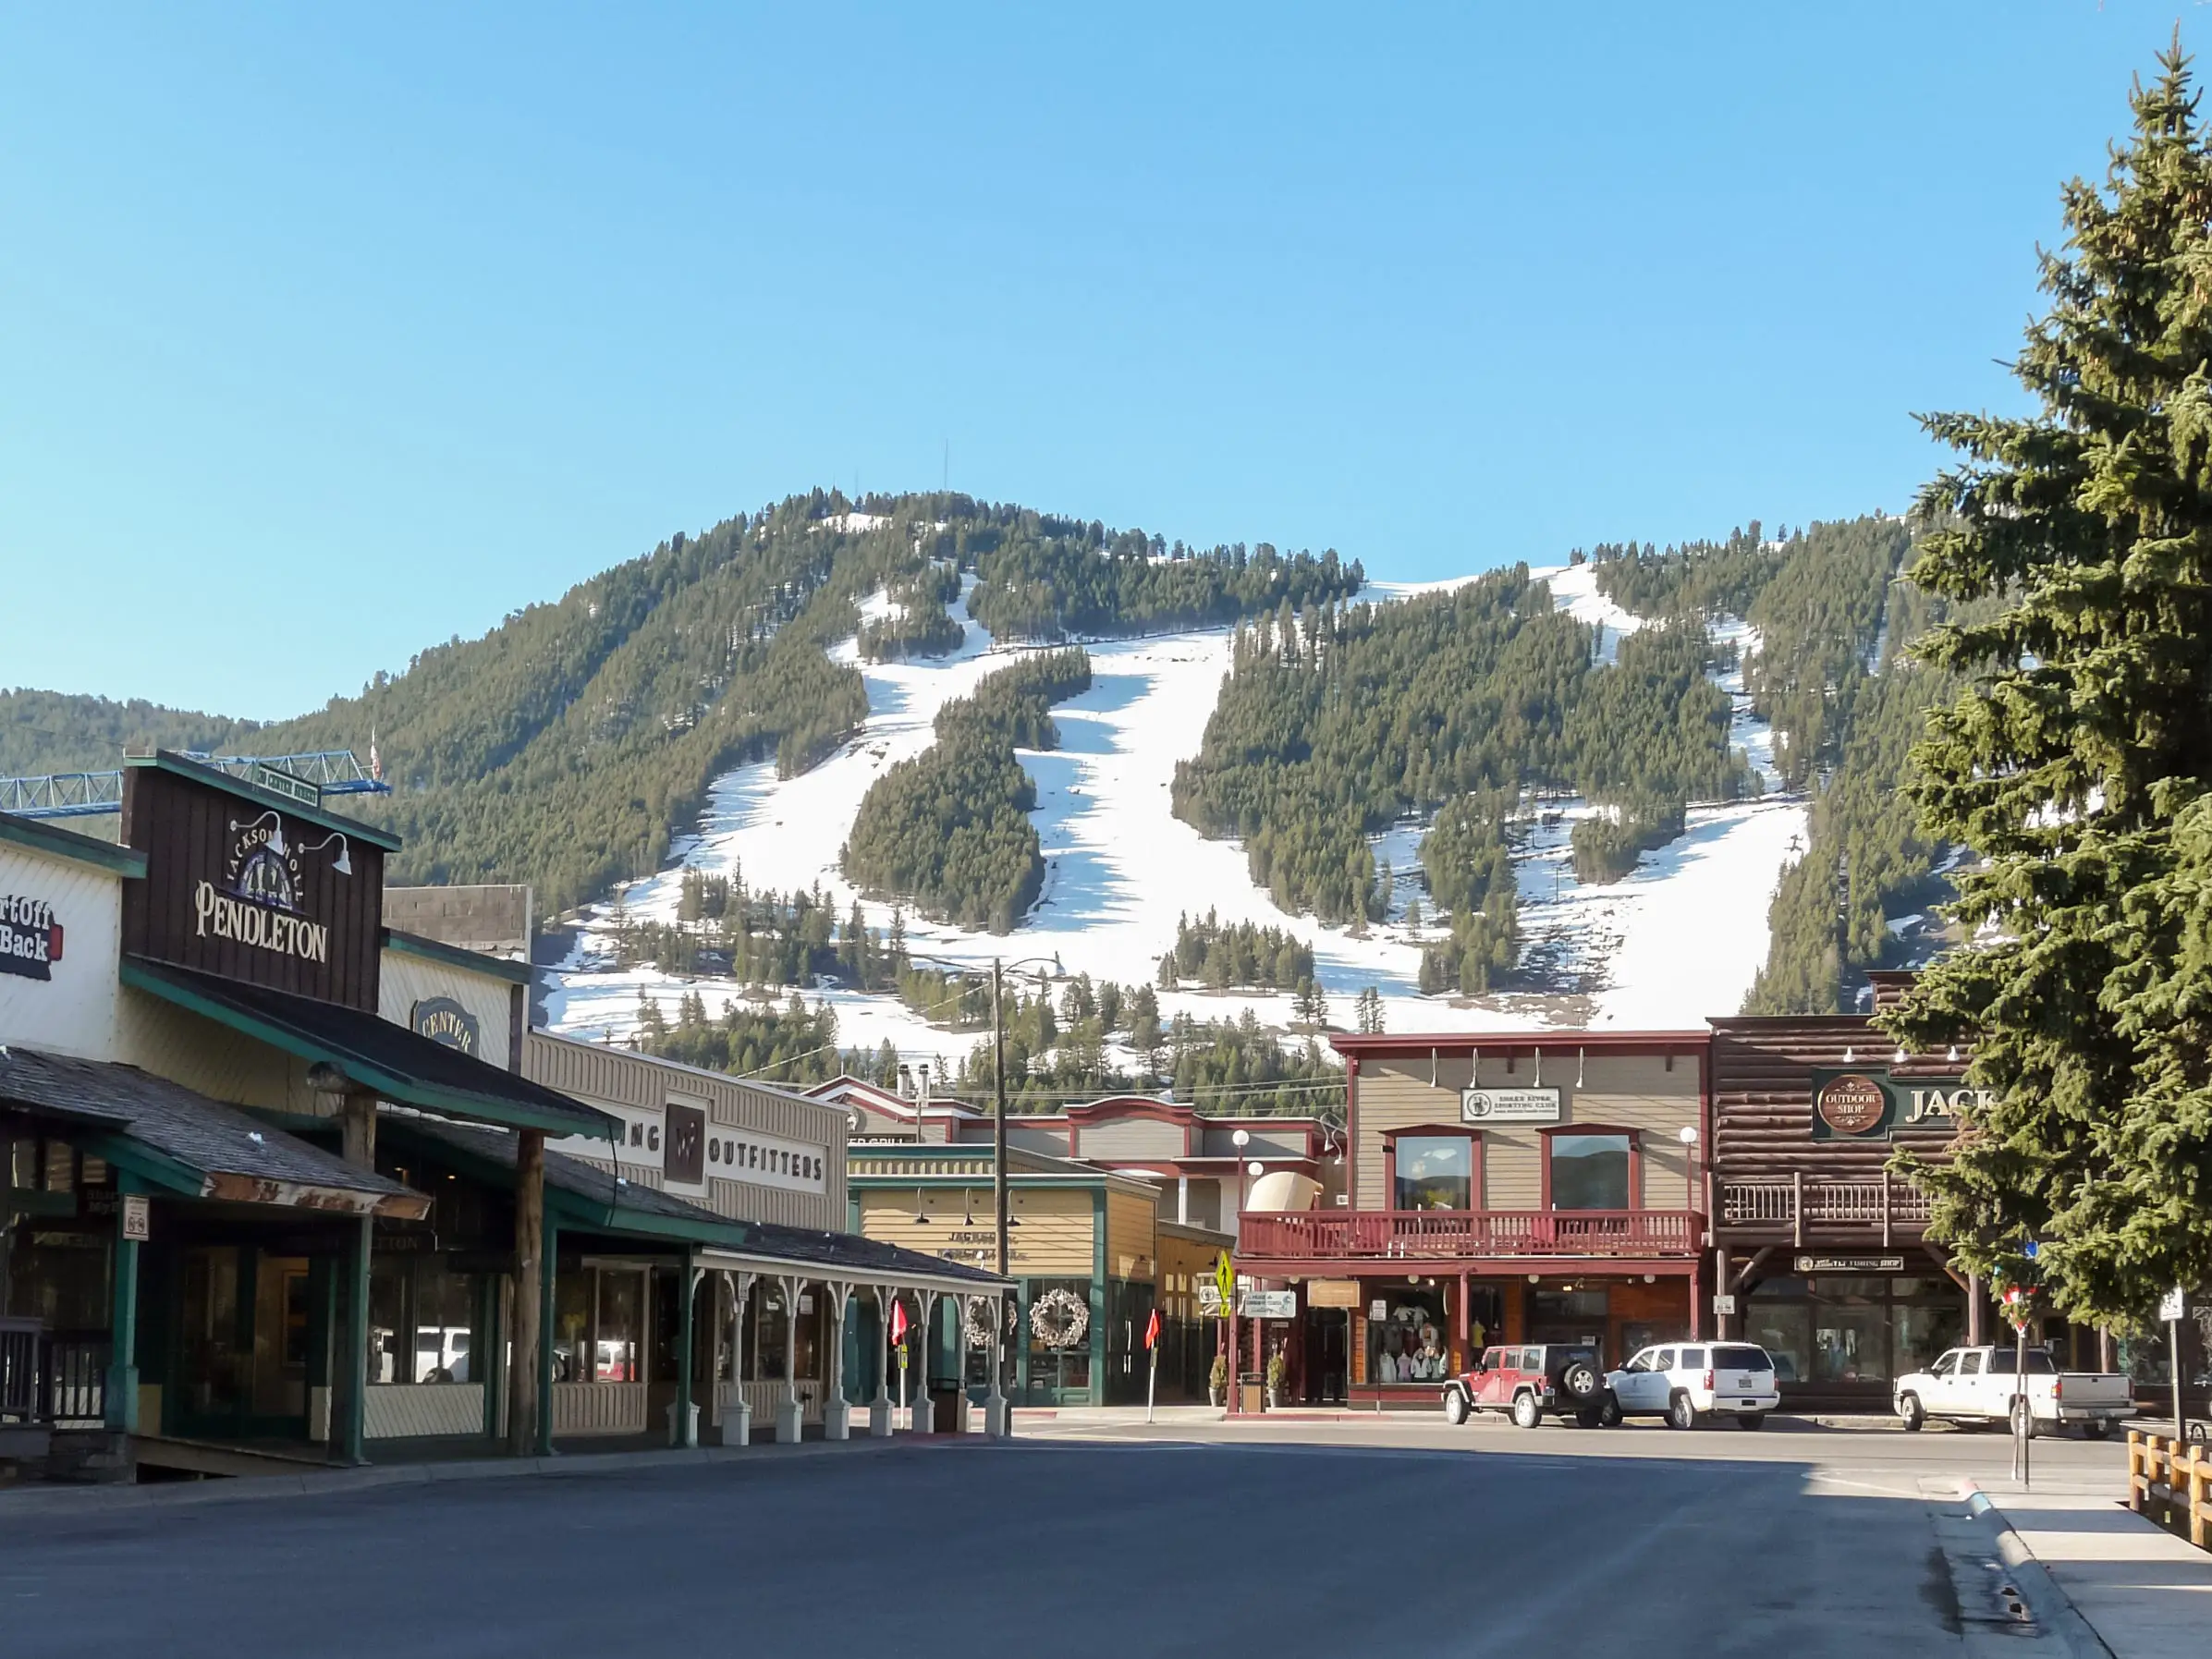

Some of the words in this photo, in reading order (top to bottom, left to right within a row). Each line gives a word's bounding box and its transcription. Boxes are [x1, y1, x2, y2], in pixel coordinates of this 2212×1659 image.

[195, 879, 327, 963] PENDLETON
[0, 925, 49, 961] Back
[422, 1011, 471, 1052] CENTER
[1826, 1093, 1876, 1104] OUTDOOR
[1837, 1104, 1864, 1115] SHOP
[1905, 1089, 1996, 1124] JACK
[708, 1137, 822, 1181] OUTFITTERS
[1880, 1259, 1901, 1267] SHOP
